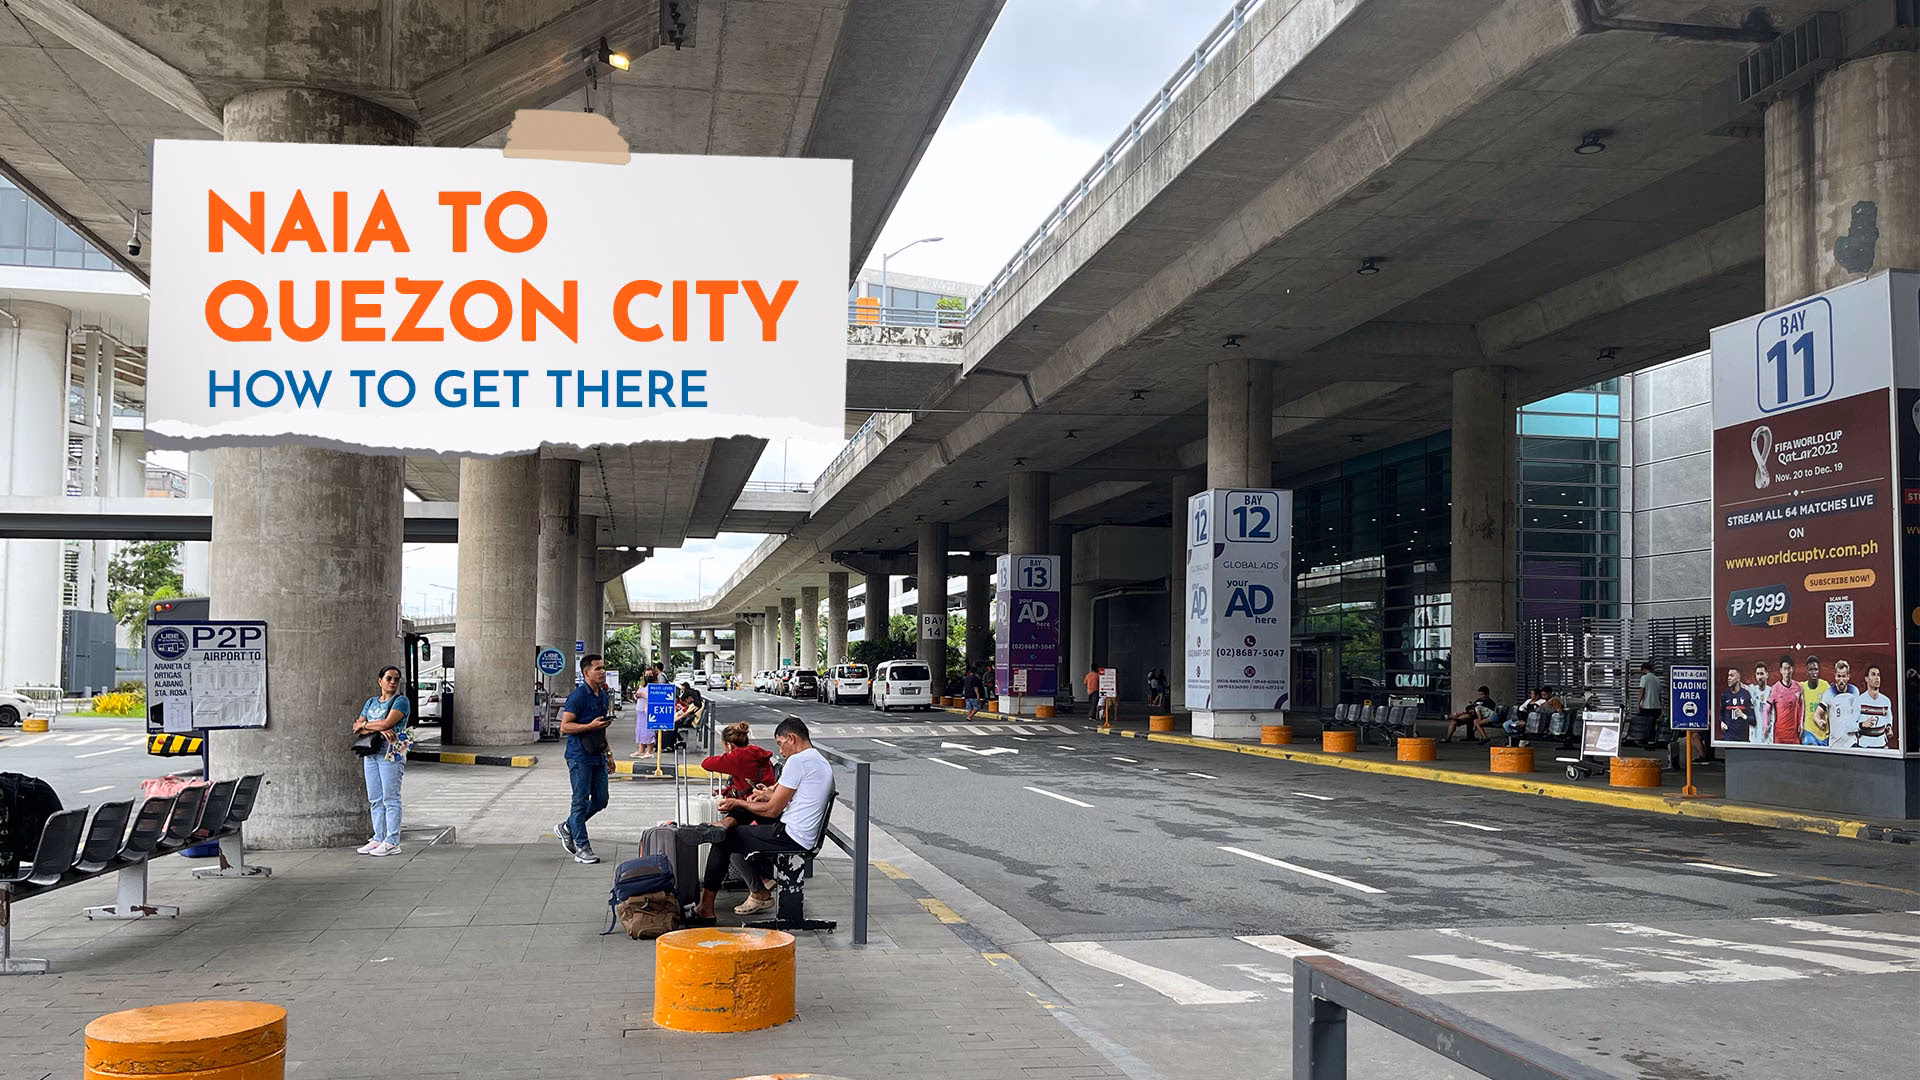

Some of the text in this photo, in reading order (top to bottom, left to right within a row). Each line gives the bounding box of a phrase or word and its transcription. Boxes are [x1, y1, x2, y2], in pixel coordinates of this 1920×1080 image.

[1780, 310, 1807, 337] BAY
[1766, 331, 1816, 404] 11
[1775, 430, 1843, 453] FIFA WORLD CUP
[1775, 462, 1843, 483] Nov. 20 to Dec. 19
[1244, 495, 1263, 505] BAY
[1727, 494, 1874, 527] STREAM ALL 64 MATCHES LIVE
[1194, 509, 1208, 542] 12
[1232, 506, 1271, 539] 12
[1788, 527, 1805, 540] ON
[1726, 539, 1879, 570] www.worldcuptv.com.ph
[1029, 559, 1042, 567] BAY
[1023, 566, 1048, 588] 13
[1809, 574, 1871, 588] SUBSCRIBE NOW!
[1226, 580, 1249, 589] your
[1224, 584, 1274, 618] AD
[1017, 601, 1049, 623] AD
[924, 616, 944, 625] BAY
[1255, 615, 1277, 624] here
[192, 626, 262, 649] P2P
[927, 627, 941, 637] 14
[203, 651, 261, 661] AIRPORT TO
[1216, 648, 1285, 658] (02)8687-5047
[154, 680, 184, 688] ALABANG
[1672, 681, 1707, 690] LOADING
[154, 689, 188, 697] STA. ROSA
[1679, 691, 1701, 700] AREA
[654, 705, 673, 714] EXIT
[1836, 707, 1841, 718] 9
